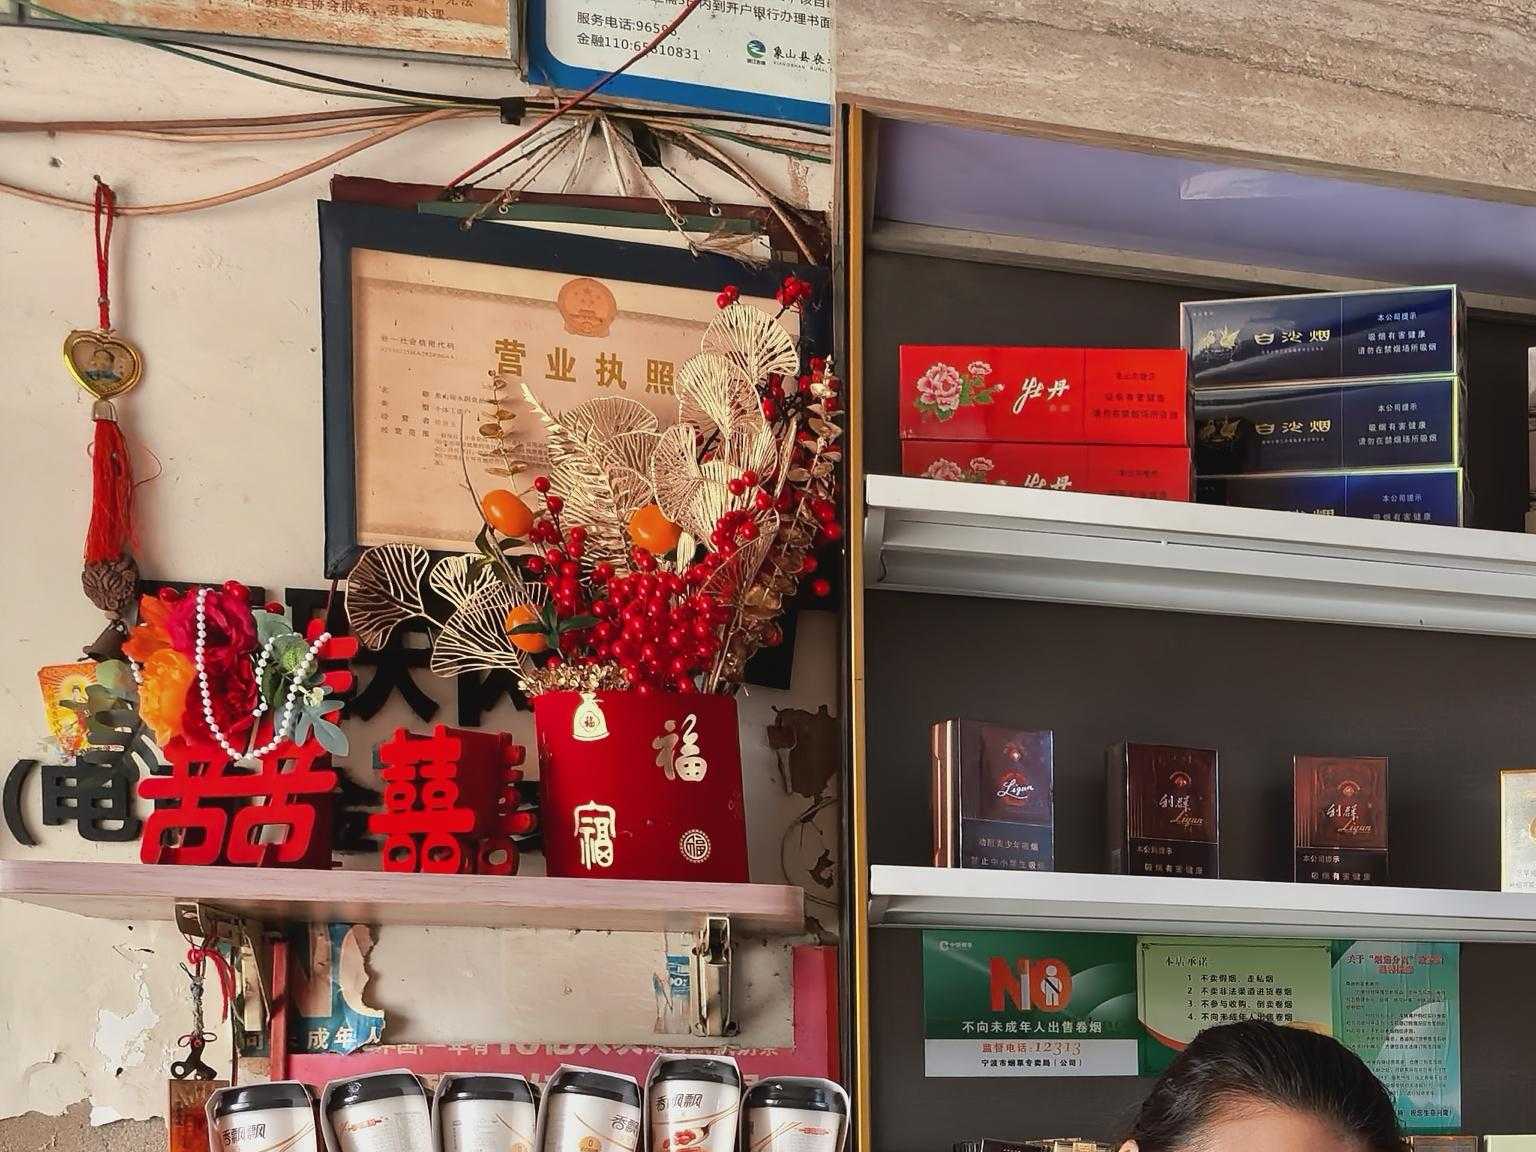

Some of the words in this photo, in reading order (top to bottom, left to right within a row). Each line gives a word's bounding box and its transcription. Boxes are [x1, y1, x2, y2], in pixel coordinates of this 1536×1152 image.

[773, 46, 831, 66] 象山县农
[1377, 311, 1418, 322] 本公司提示
[1368, 330, 1427, 342] 吸烟有害健康
[1357, 343, 1438, 355] 请勿在禁烟场所吸烟
[495, 338, 675, 396] 营业执照
[1013, 377, 1070, 414] 牡丹
[1377, 402, 1418, 413] 本公司提示
[1368, 420, 1427, 432] 吸烟有害健康
[1358, 434, 1438, 446] 请勿在禁烟场所吸烟
[1382, 493, 1423, 504] 本公司提示
[651, 712, 708, 783] 福
[997, 780, 1034, 800] Liqun
[1159, 793, 1192, 812] 利群
[1326, 802, 1360, 820] 利群
[1165, 955, 1208, 968] 本店承诺
[990, 956, 1072, 1013] NO
[961, 1020, 1102, 1034] 不向未成年人出售卷烟
